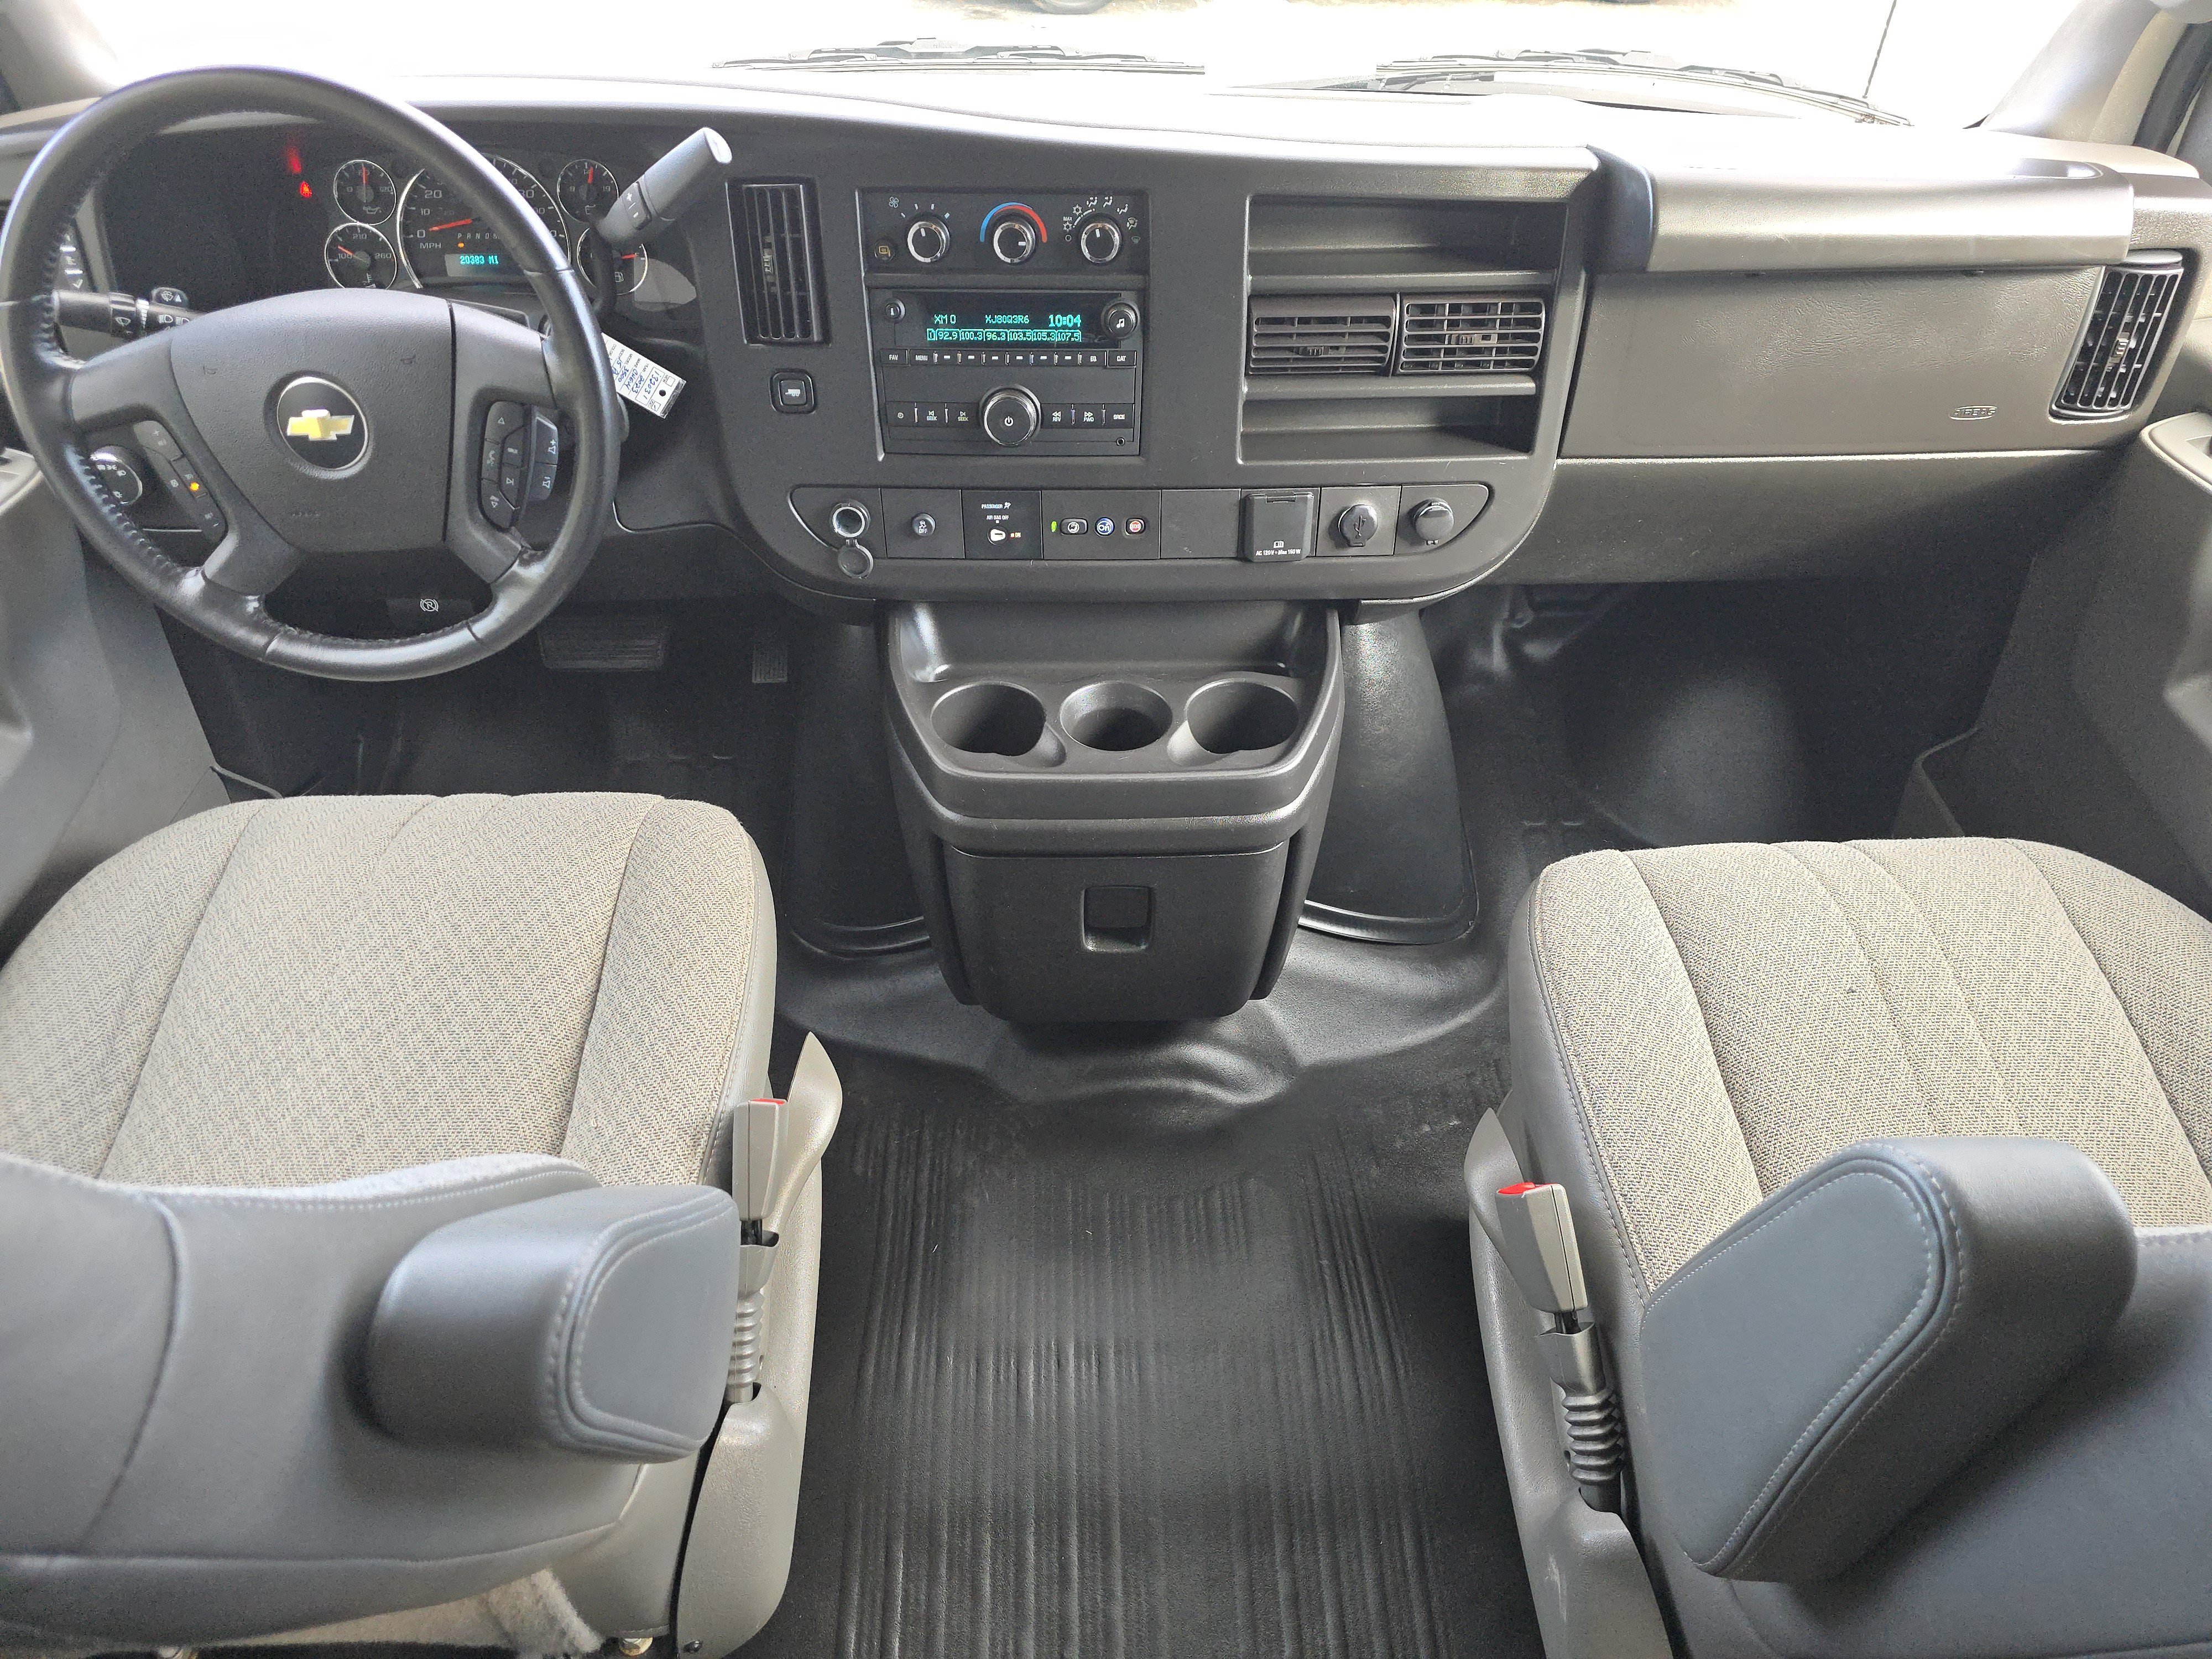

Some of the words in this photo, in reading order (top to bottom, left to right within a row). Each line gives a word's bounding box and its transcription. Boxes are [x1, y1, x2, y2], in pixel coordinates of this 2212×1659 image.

[424, 190, 442, 199] 20
[416, 229, 426, 238] 0
[460, 255, 484, 264] 20383
[934, 314, 948, 324] XM
[1048, 314, 1081, 327] 10:04
[938, 331, 958, 340] 92.9
[961, 331, 983, 340] 100.3
[986, 332, 1006, 341] 96.3
[1009, 332, 1032, 341] 103.5
[1033, 332, 1056, 341] 105.3
[1057, 332, 1080, 341] 107.5
[618, 366, 629, 383] 3500
[632, 375, 645, 394] 2023
